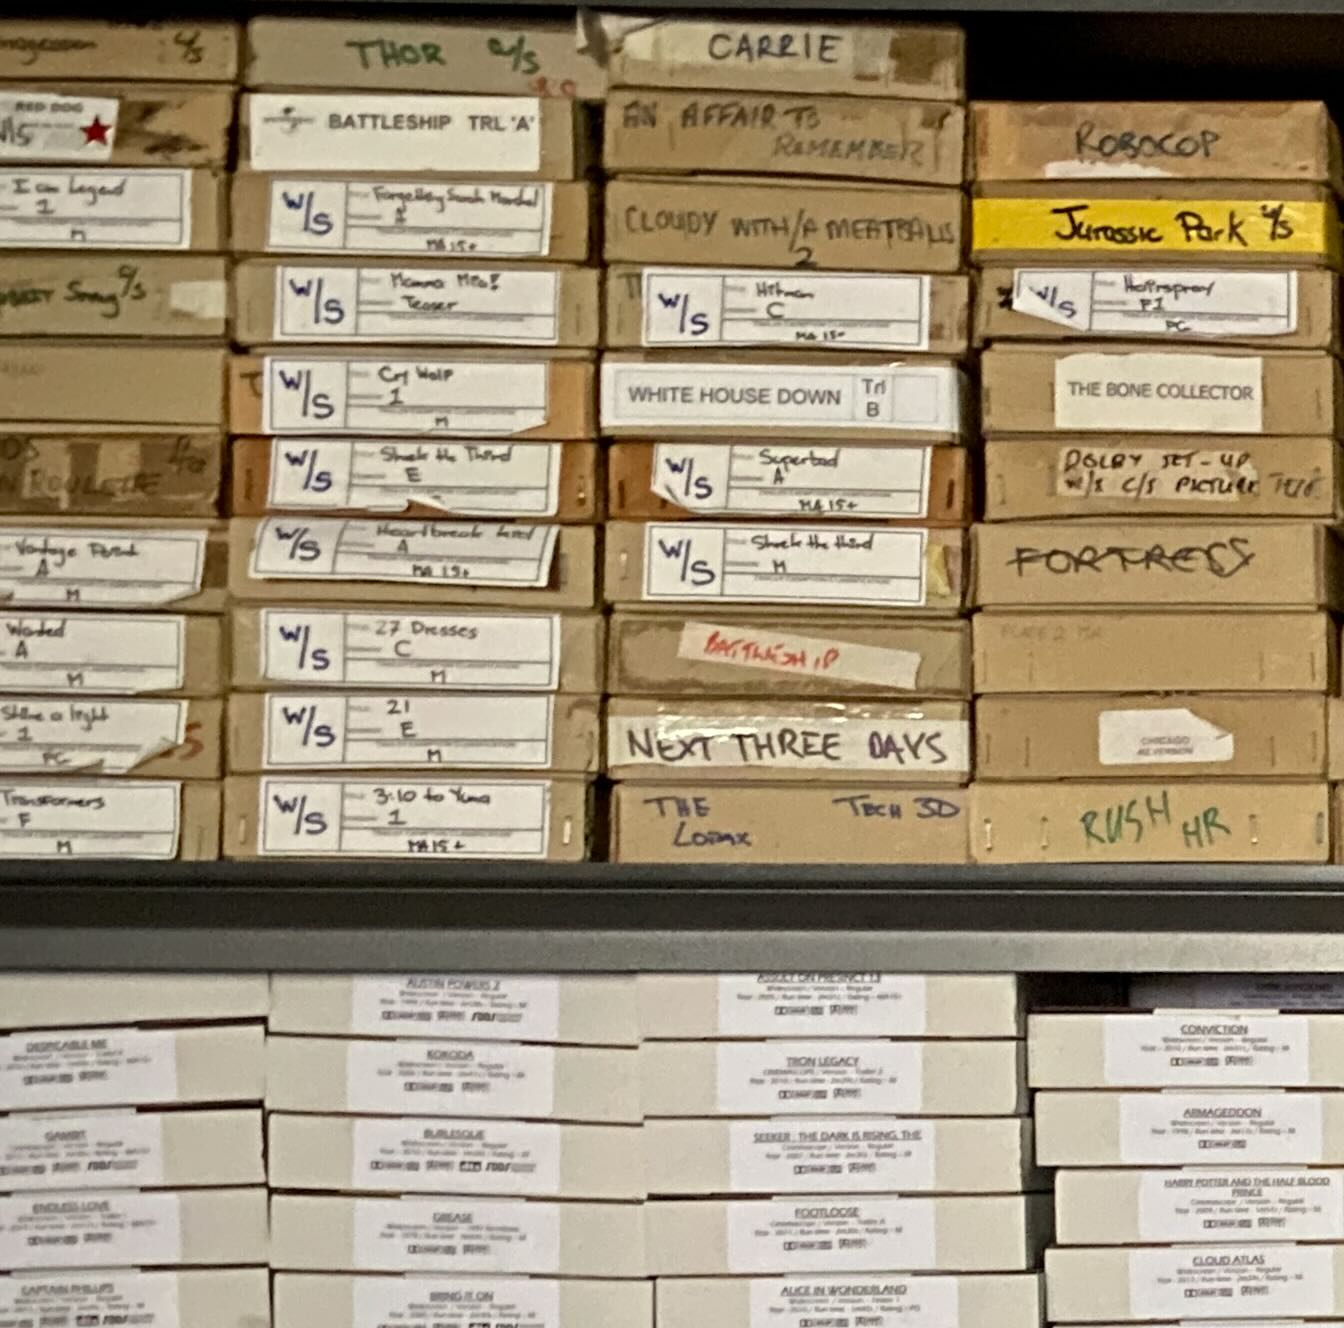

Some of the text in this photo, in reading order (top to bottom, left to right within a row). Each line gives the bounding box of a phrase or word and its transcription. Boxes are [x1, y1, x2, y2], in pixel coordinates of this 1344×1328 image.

[346, 38, 445, 67] THOR
[709, 34, 841, 62] CARRIE
[15, 101, 83, 113] RED DOG
[327, 114, 451, 130] BATTLESHIP
[469, 115, 504, 131] TRL
[623, 104, 775, 128] AN AFFAIR
[773, 134, 925, 166] REMEMBER
[1075, 118, 1220, 160] ROBOCOP
[284, 192, 334, 234] W/S
[625, 207, 954, 243] CLOUDY MEATBALLS
[1052, 204, 1247, 247] Jurassic Park
[288, 279, 345, 323] W/S
[659, 294, 709, 334] W/S
[280, 370, 334, 418] W/S
[629, 387, 840, 405] WHITE HOUSE DOWN
[1068, 383, 1253, 400] THE BONE COLLECTOR
[867, 402, 879, 417] B
[286, 451, 332, 491] W/S
[665, 457, 713, 499] W/S
[276, 528, 321, 560] W/S
[1007, 540, 1257, 578] FORTRESS
[659, 540, 715, 585] W/S
[376, 621, 477, 639] 27 Dresses
[280, 626, 330, 669] W/S
[387, 700, 410, 714] 21
[282, 707, 335, 745] W/S
[629, 730, 947, 763] NEXT THREE DAYS
[274, 796, 327, 834] W/S
[643, 798, 709, 818] THE
[915, 798, 960, 818] 3D
[1079, 791, 1171, 843] RUSH
[1182, 807, 1231, 846] HR
[1180, 1025, 1248, 1035] CONVICTION
[786, 1057, 860, 1066] TRON LEGACY
[1183, 1108, 1262, 1118] ARMAGEDDON
[753, 1132, 848, 1142] SEEKER DARK
[1192, 1254, 1265, 1265] CLOUD ATLAS
